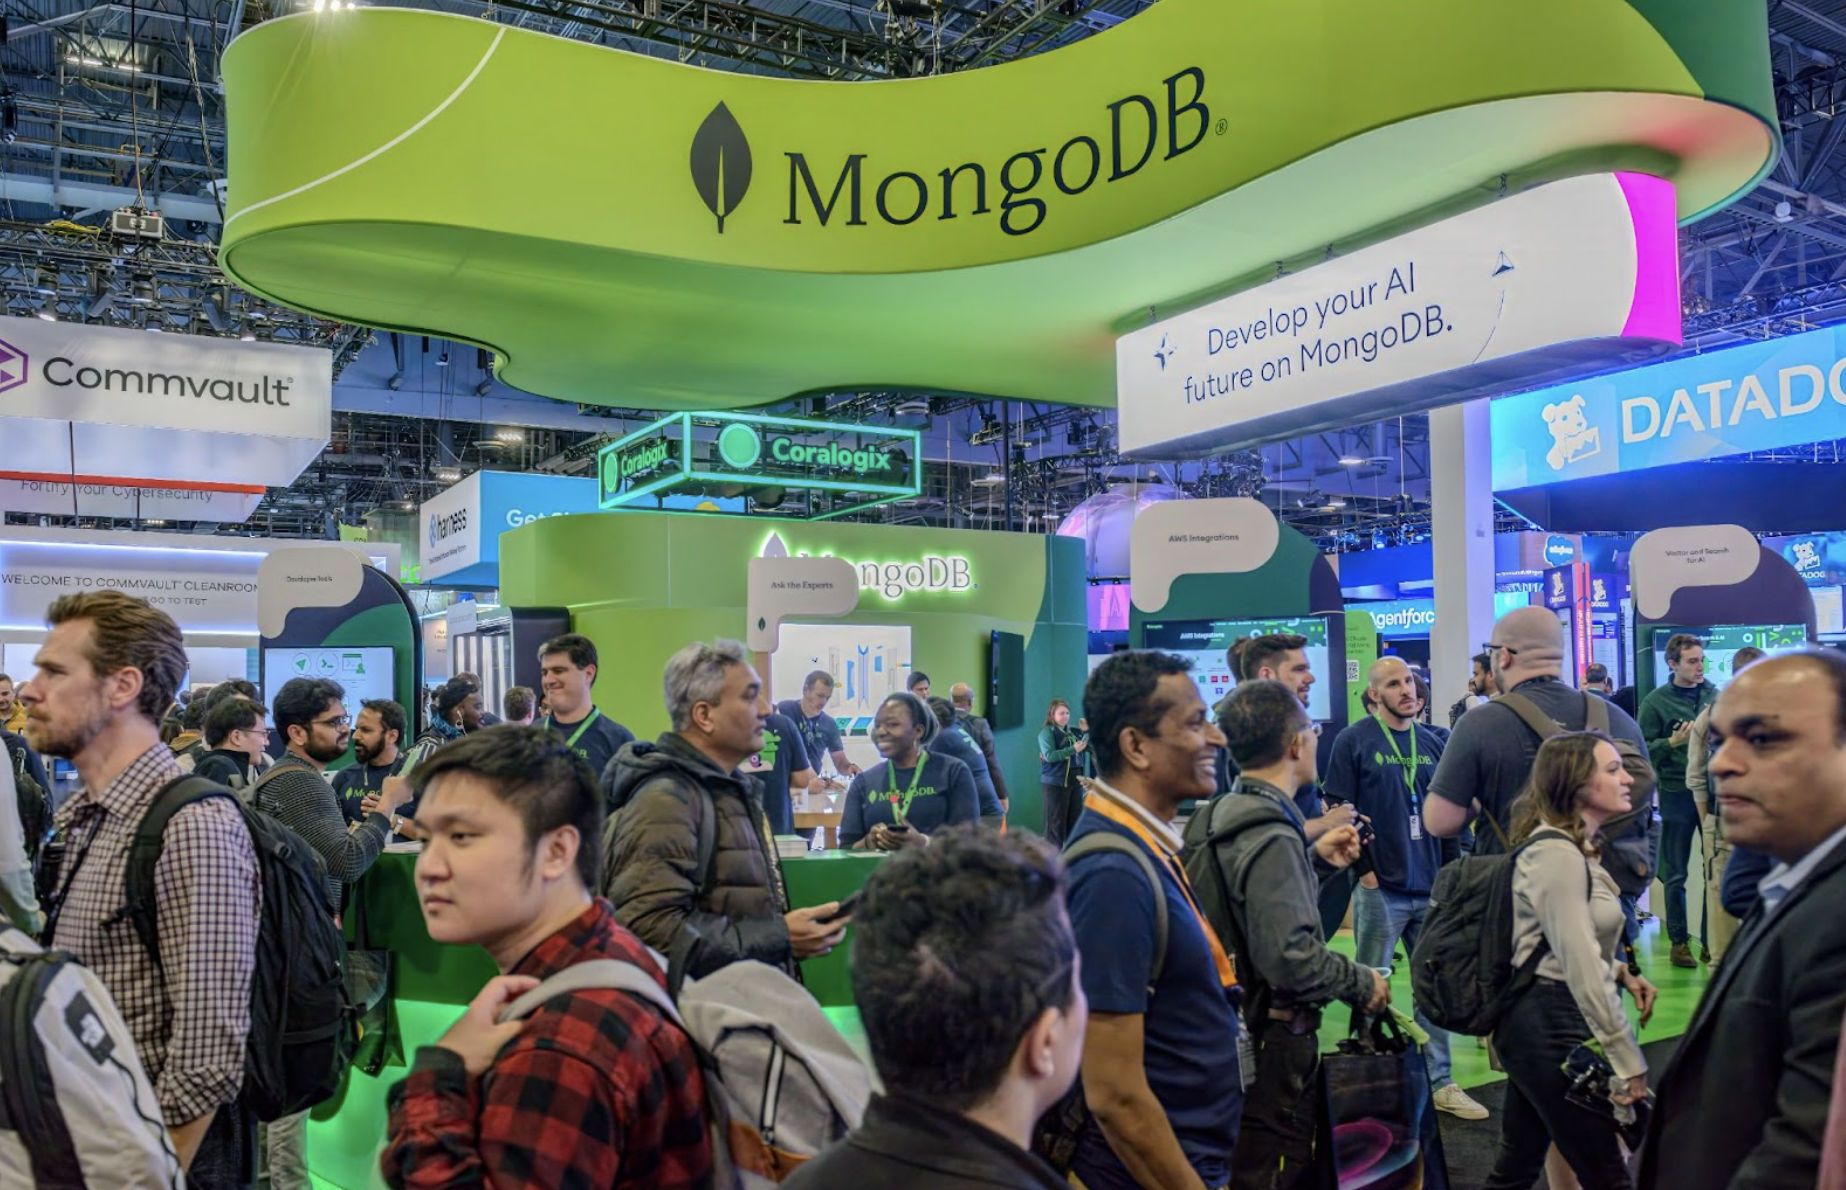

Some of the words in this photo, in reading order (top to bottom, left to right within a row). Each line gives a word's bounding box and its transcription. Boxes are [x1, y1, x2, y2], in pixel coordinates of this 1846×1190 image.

[1208, 306, 1308, 356] Develop
[1315, 280, 1378, 329] your
[1385, 261, 1416, 301] AI
[1184, 366, 1253, 404] future
[1261, 354, 1291, 382] on
[1301, 304, 1454, 373] MongoDB.
[621, 438, 668, 477] Coralogix
[772, 437, 891, 473] Coralogix
[21, 480, 69, 495] Fortify
[76, 484, 106, 496] Your
[112, 487, 213, 503] Cybersecurity
[436, 508, 467, 541] harness
[1168, 535, 1188, 543] AWS
[1189, 533, 1239, 544] Integrations
[1, 574, 71, 586] WELCOME
[75, 577, 92, 587] TO
[771, 581, 784, 589] Ask
[787, 581, 801, 589] the
[802, 581, 833, 591] Experts
[150, 596, 165, 604] GO
[167, 597, 181, 605] TO
[184, 597, 207, 606] TEST
